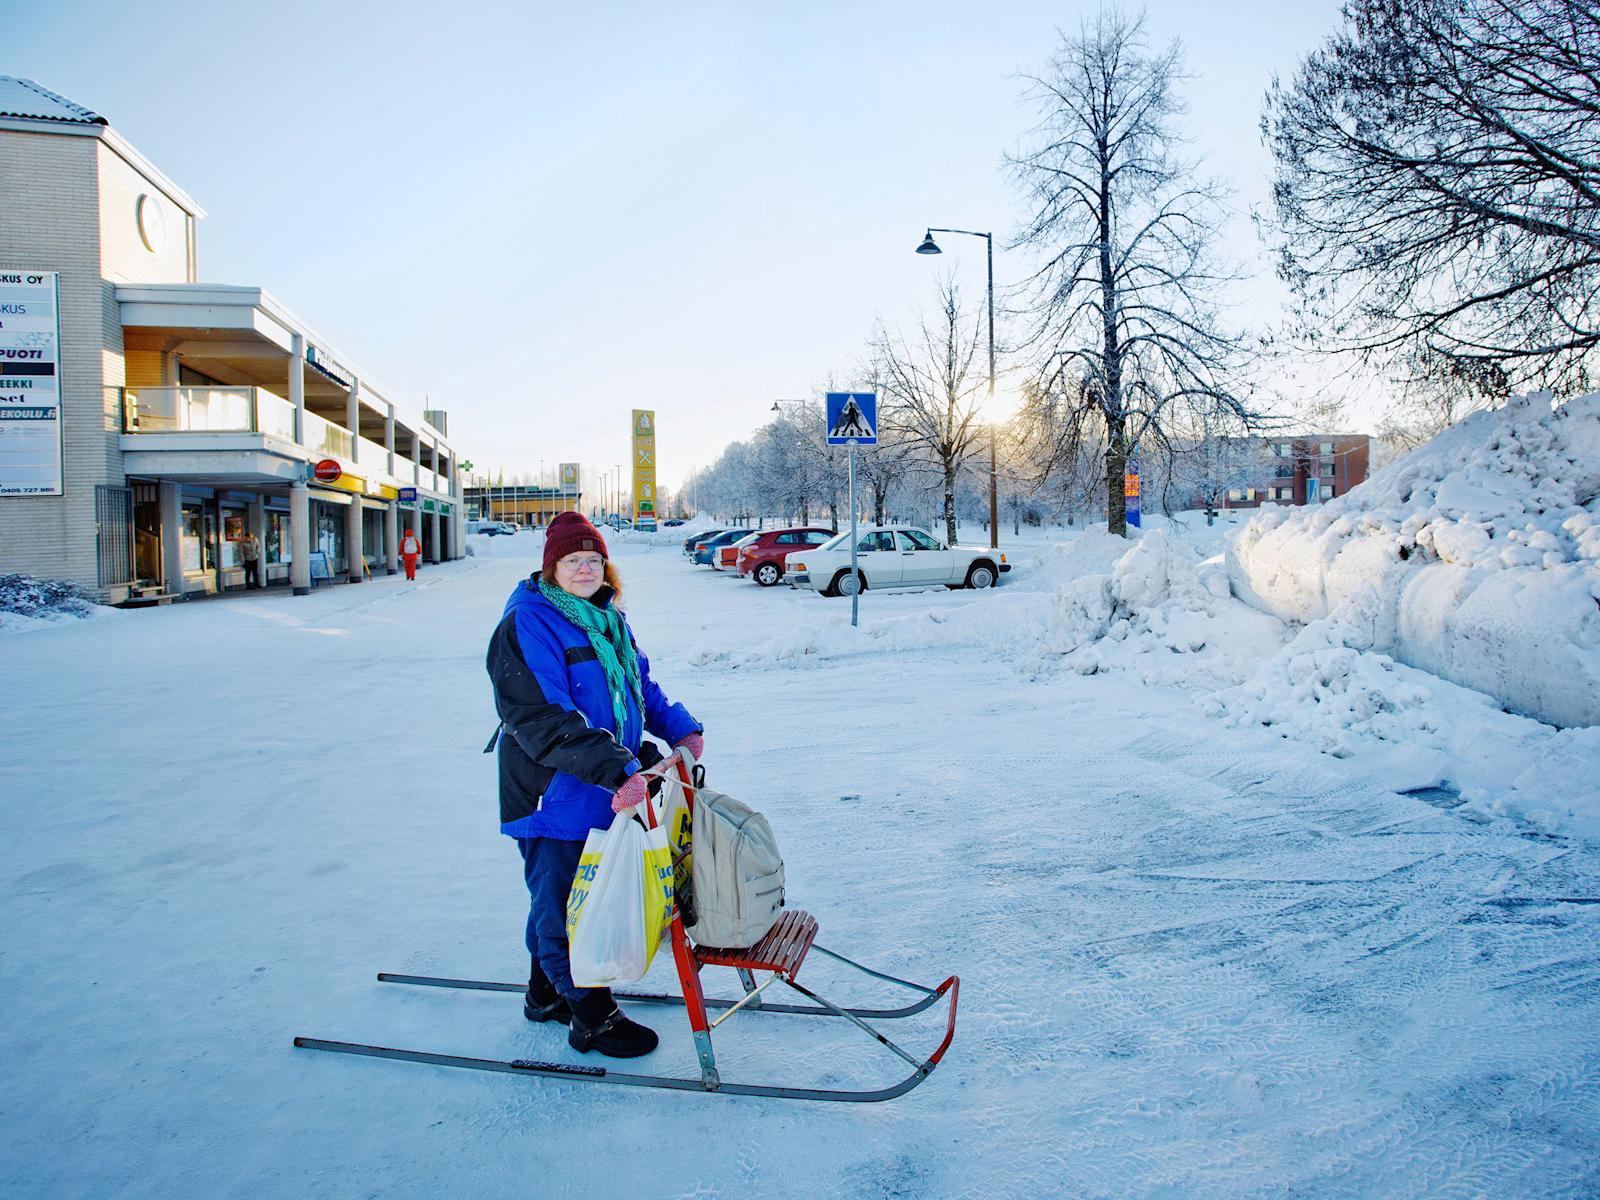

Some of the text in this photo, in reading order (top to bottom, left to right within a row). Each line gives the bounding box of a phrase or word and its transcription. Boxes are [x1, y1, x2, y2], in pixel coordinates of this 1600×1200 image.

[0, 275, 43, 284] KUS OY
[0, 304, 26, 315] KUS
